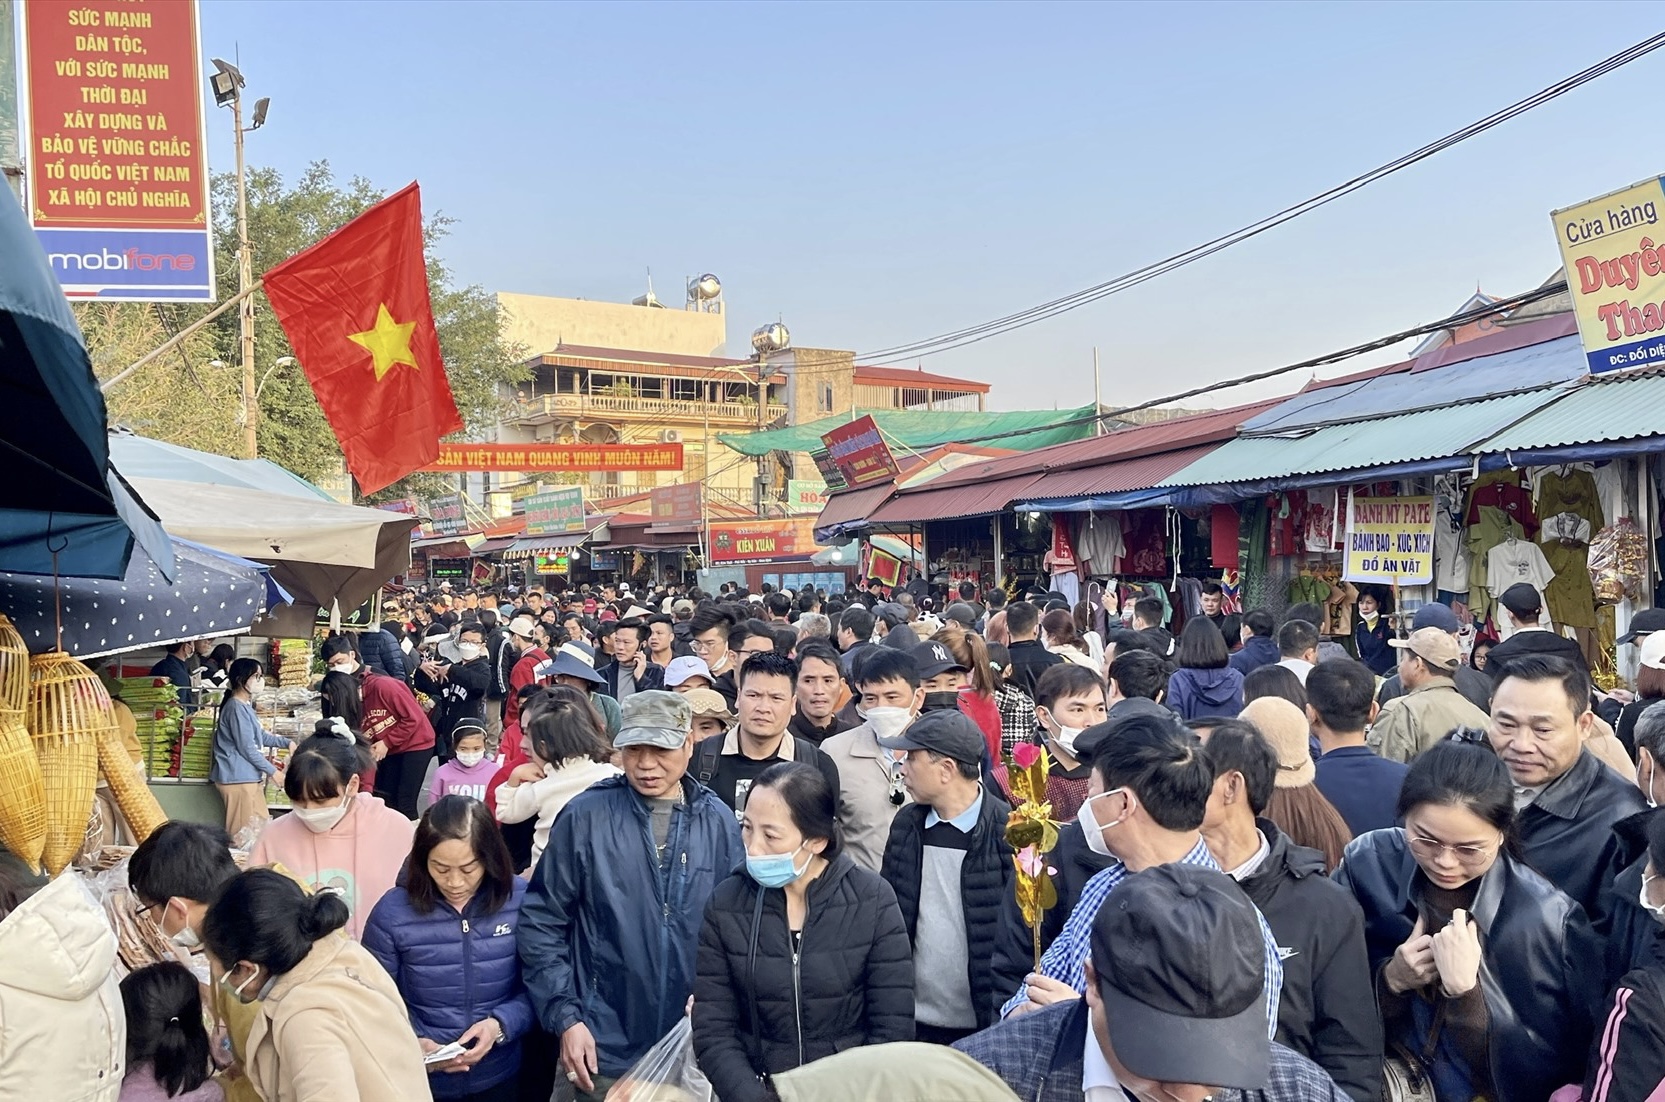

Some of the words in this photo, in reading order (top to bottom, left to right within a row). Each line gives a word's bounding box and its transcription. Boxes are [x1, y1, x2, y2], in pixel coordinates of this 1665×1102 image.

[69, 7, 100, 26] SỨC
[104, 11, 152, 31] MẠNH
[76, 33, 108, 51] DÂN
[112, 34, 147, 55] TỘC,
[56, 60, 81, 77] VỚI
[86, 60, 117, 78] SỨC
[122, 64, 169, 82] MẠNH
[81, 84, 116, 104] THỜI
[120, 89, 147, 108] ĐẠI
[63, 110, 94, 129] XÂY
[100, 114, 142, 131] DỰNG
[147, 112, 167, 131] VÀ
[42, 135, 73, 154] BẢO
[79, 136, 98, 158] VỆ
[102, 137, 145, 155] VỮNG
[149, 136, 191, 156] CHẮC
[45, 158, 65, 179] TỔ
[70, 159, 112, 180] QUỐC
[116, 162, 149, 185] VIỆT
[154, 166, 190, 182] NAM
[48, 188, 70, 206] XÃ
[75, 188, 101, 209] HỘI
[106, 187, 138, 207] CHỦ
[142, 191, 191, 208] NGHĨA
[1566, 218, 1604, 243] Cửa
[1607, 201, 1657, 231] hàng
[48, 248, 195, 271] mobifone
[1610, 353, 1628, 365] ĐC:
[1629, 346, 1648, 361] ĐỐI
[1650, 341, 1665, 359] DIỆ
[466, 448, 492, 469] VIỆT
[496, 452, 525, 465] NAM
[529, 452, 570, 467] QUANG
[573, 452, 600, 465] VINH
[605, 448, 640, 465] MUÔN
[644, 448, 675, 465] NĂM!
[1404, 504, 1431, 523] PATE
[1353, 529, 1374, 552] BÁNH
[1377, 533, 1390, 552] BAO
[1397, 530, 1411, 552] XÚC
[1414, 530, 1430, 553] XÍCH
[1383, 558, 1398, 572] ĂN
